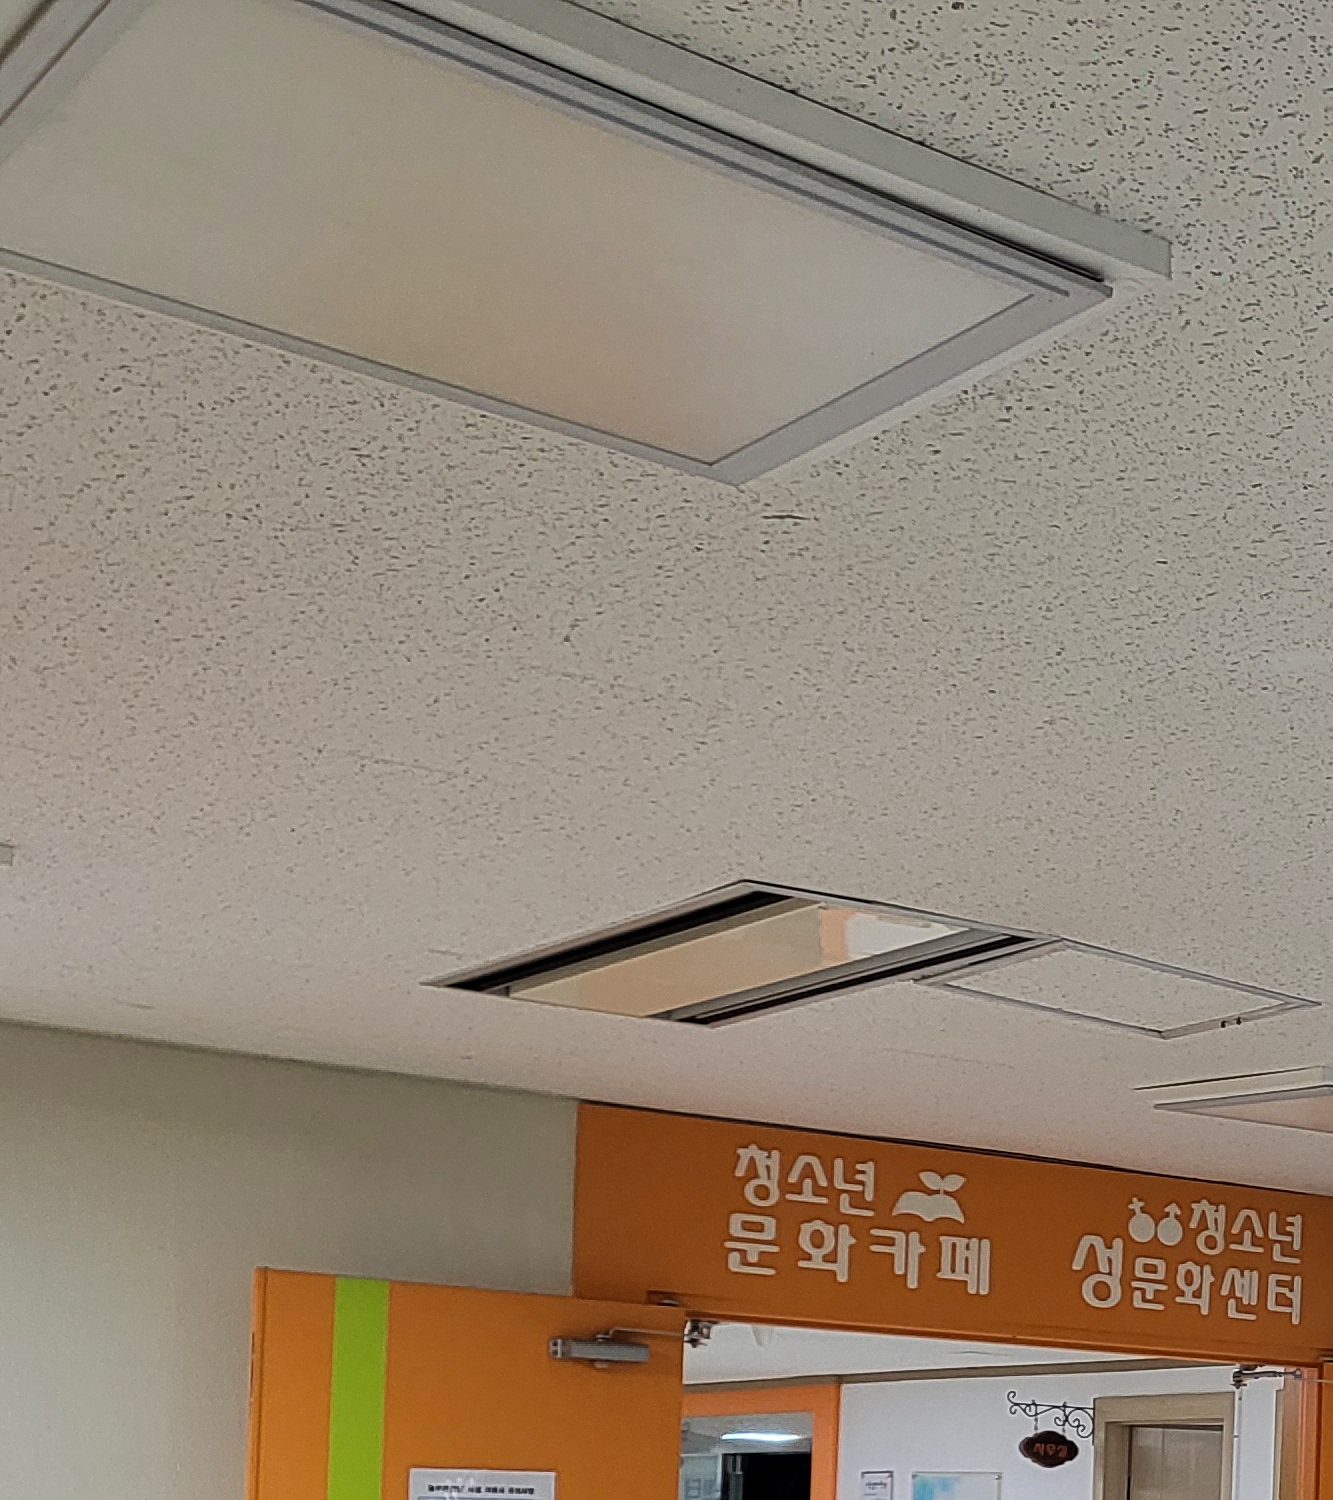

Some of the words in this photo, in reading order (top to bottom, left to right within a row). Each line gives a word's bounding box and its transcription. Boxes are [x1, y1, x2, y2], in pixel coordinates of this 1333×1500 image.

[734, 1144, 875, 1218] 청소년
[724, 1213, 990, 1295] 문화카페
[1190, 1199, 1303, 1265] 청소년
[1072, 1233, 1303, 1326] 성문화센터
